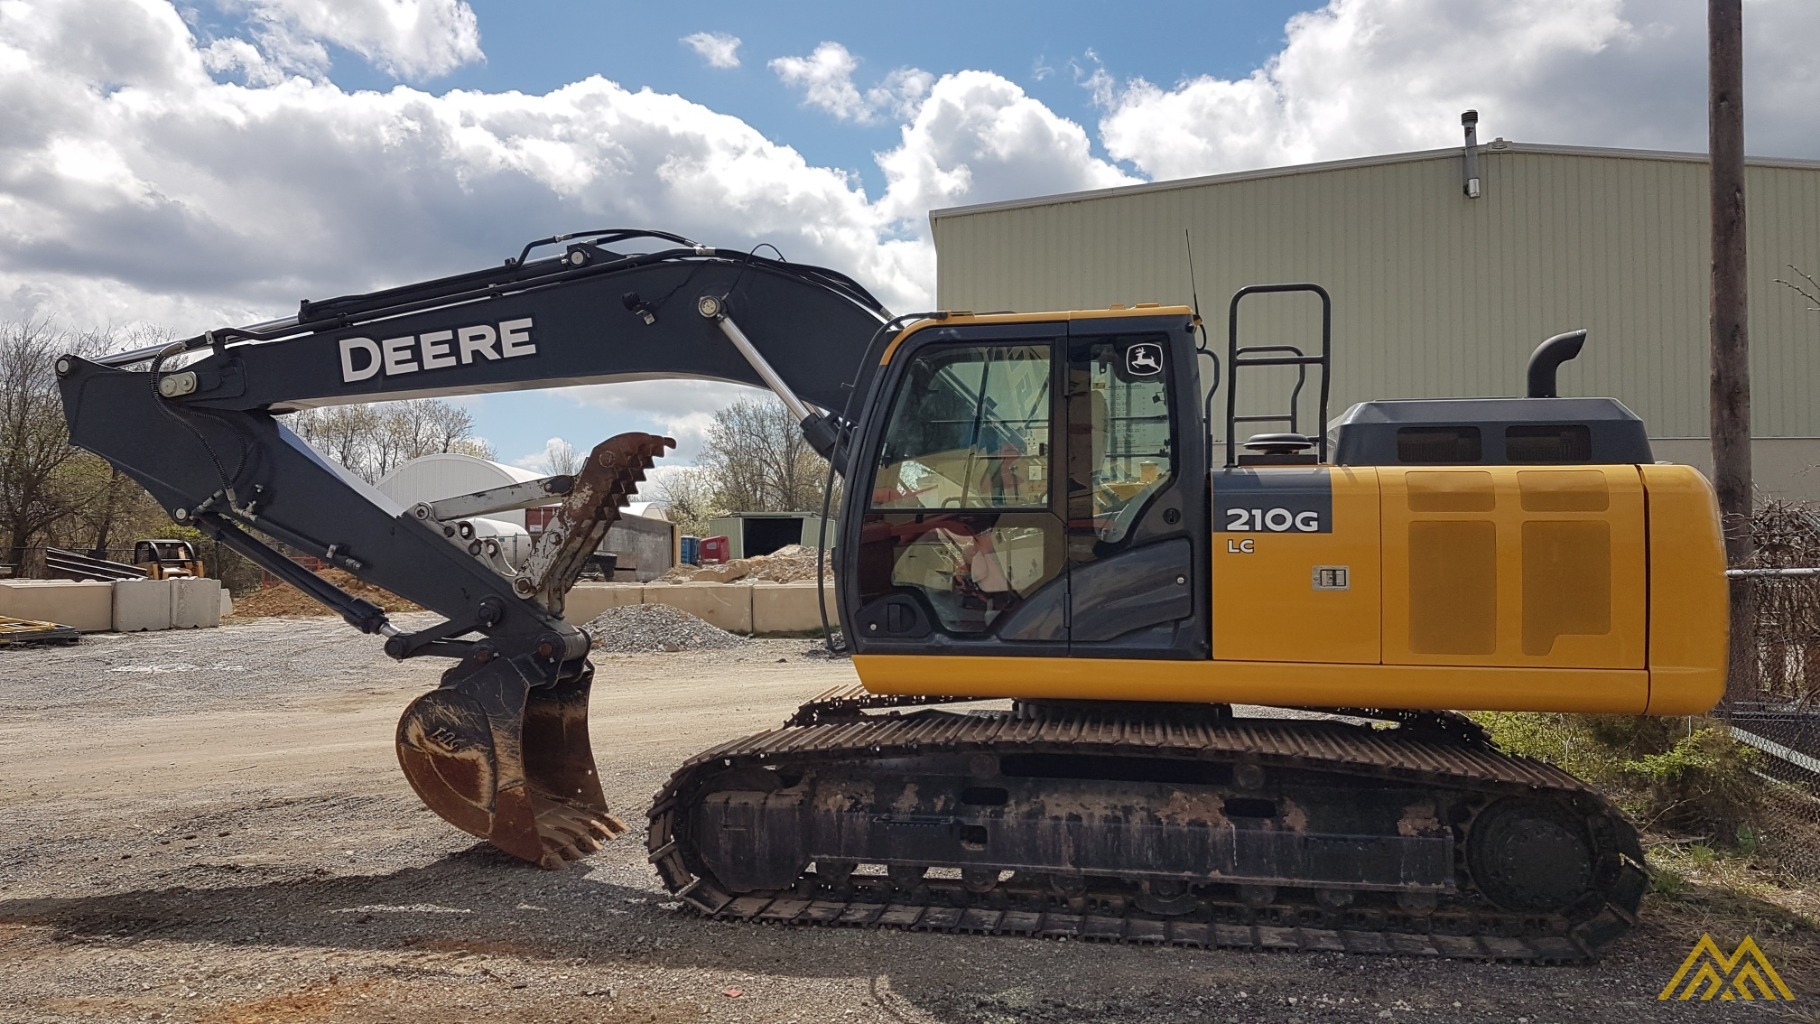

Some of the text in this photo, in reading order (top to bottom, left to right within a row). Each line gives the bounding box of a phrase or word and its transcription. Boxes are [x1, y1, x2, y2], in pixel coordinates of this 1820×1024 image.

[338, 317, 537, 383] DEERE
[1226, 507, 1319, 532] 210G
[1227, 539, 1255, 553] LC
